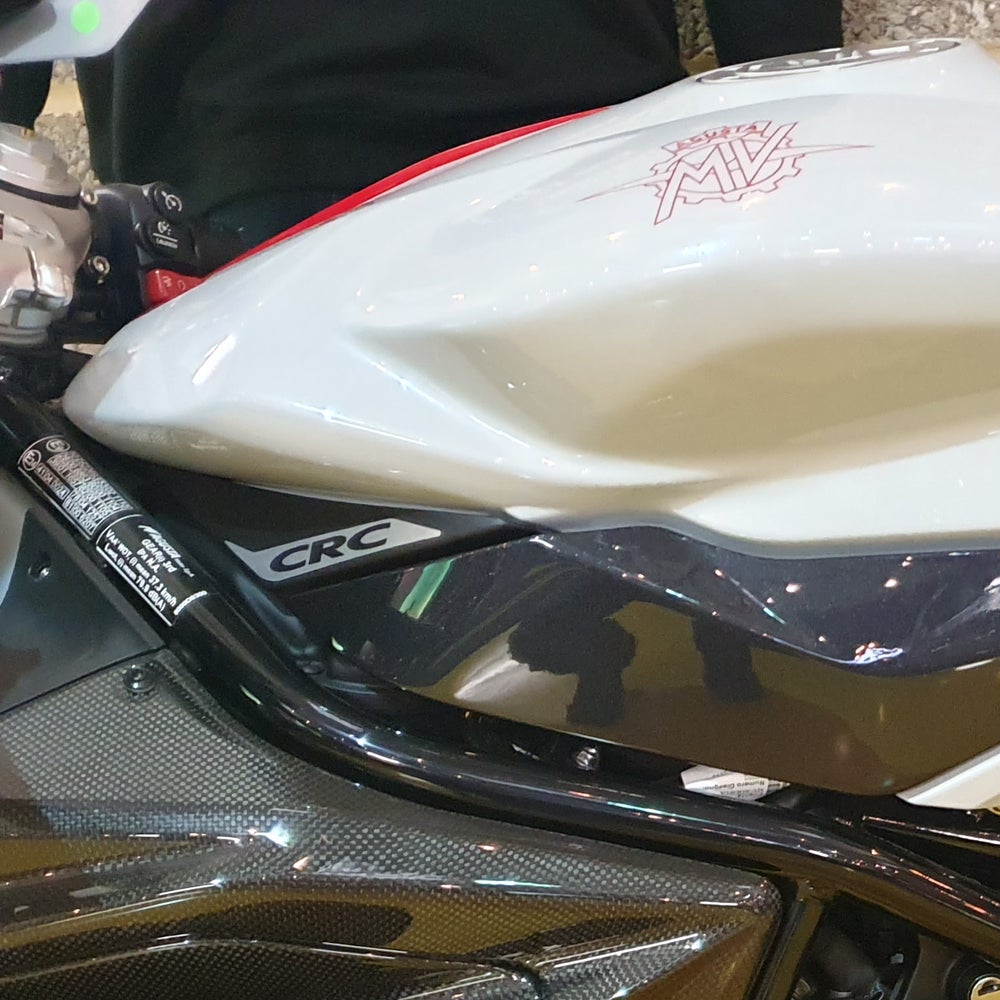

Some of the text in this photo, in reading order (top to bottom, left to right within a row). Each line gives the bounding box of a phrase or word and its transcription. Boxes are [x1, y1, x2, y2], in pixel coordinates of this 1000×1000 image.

[675, 125, 759, 150] AGUSTA
[654, 122, 798, 225] MV
[269, 522, 391, 573] CRC
[149, 575, 164, 591] 37.3
[160, 588, 177, 607] km/h
